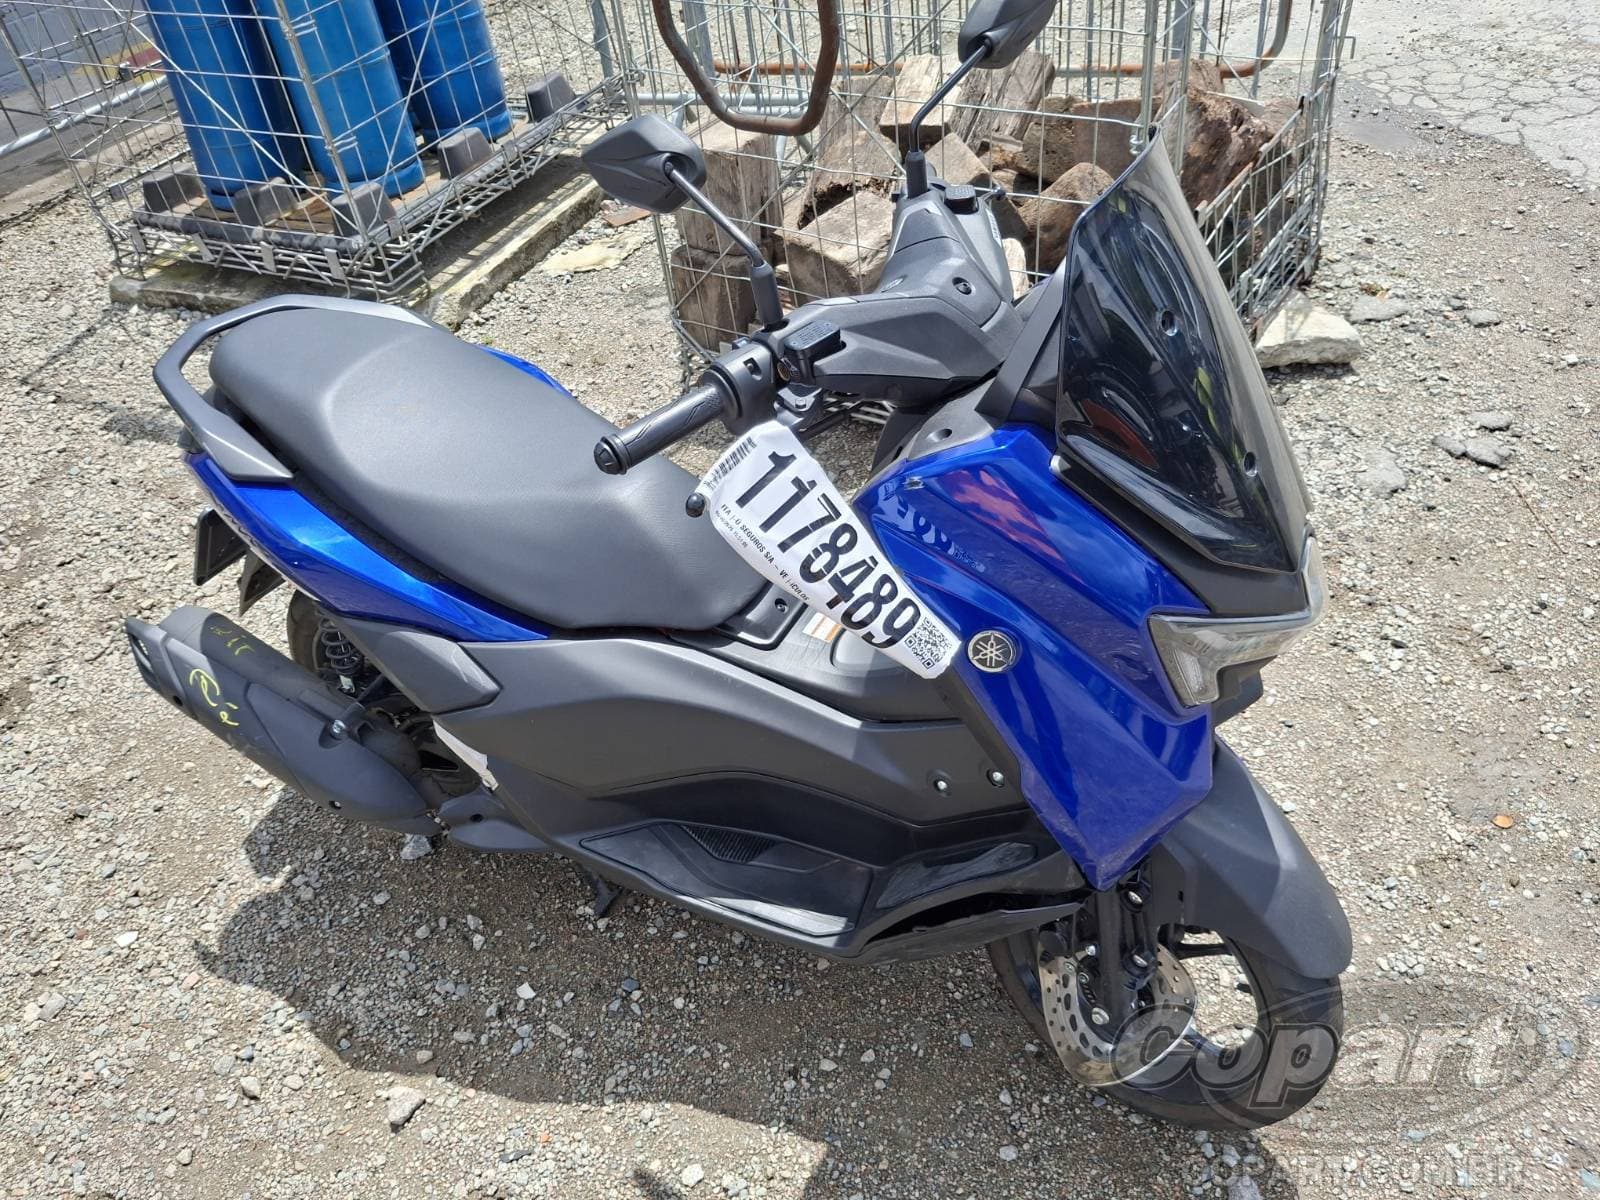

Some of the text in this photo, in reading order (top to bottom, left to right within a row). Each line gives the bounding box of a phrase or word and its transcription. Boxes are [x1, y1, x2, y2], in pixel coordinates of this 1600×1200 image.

[736, 451, 921, 648] 1178489
[740, 524, 766, 553] SEGUROS
[764, 551, 775, 564] S/A
